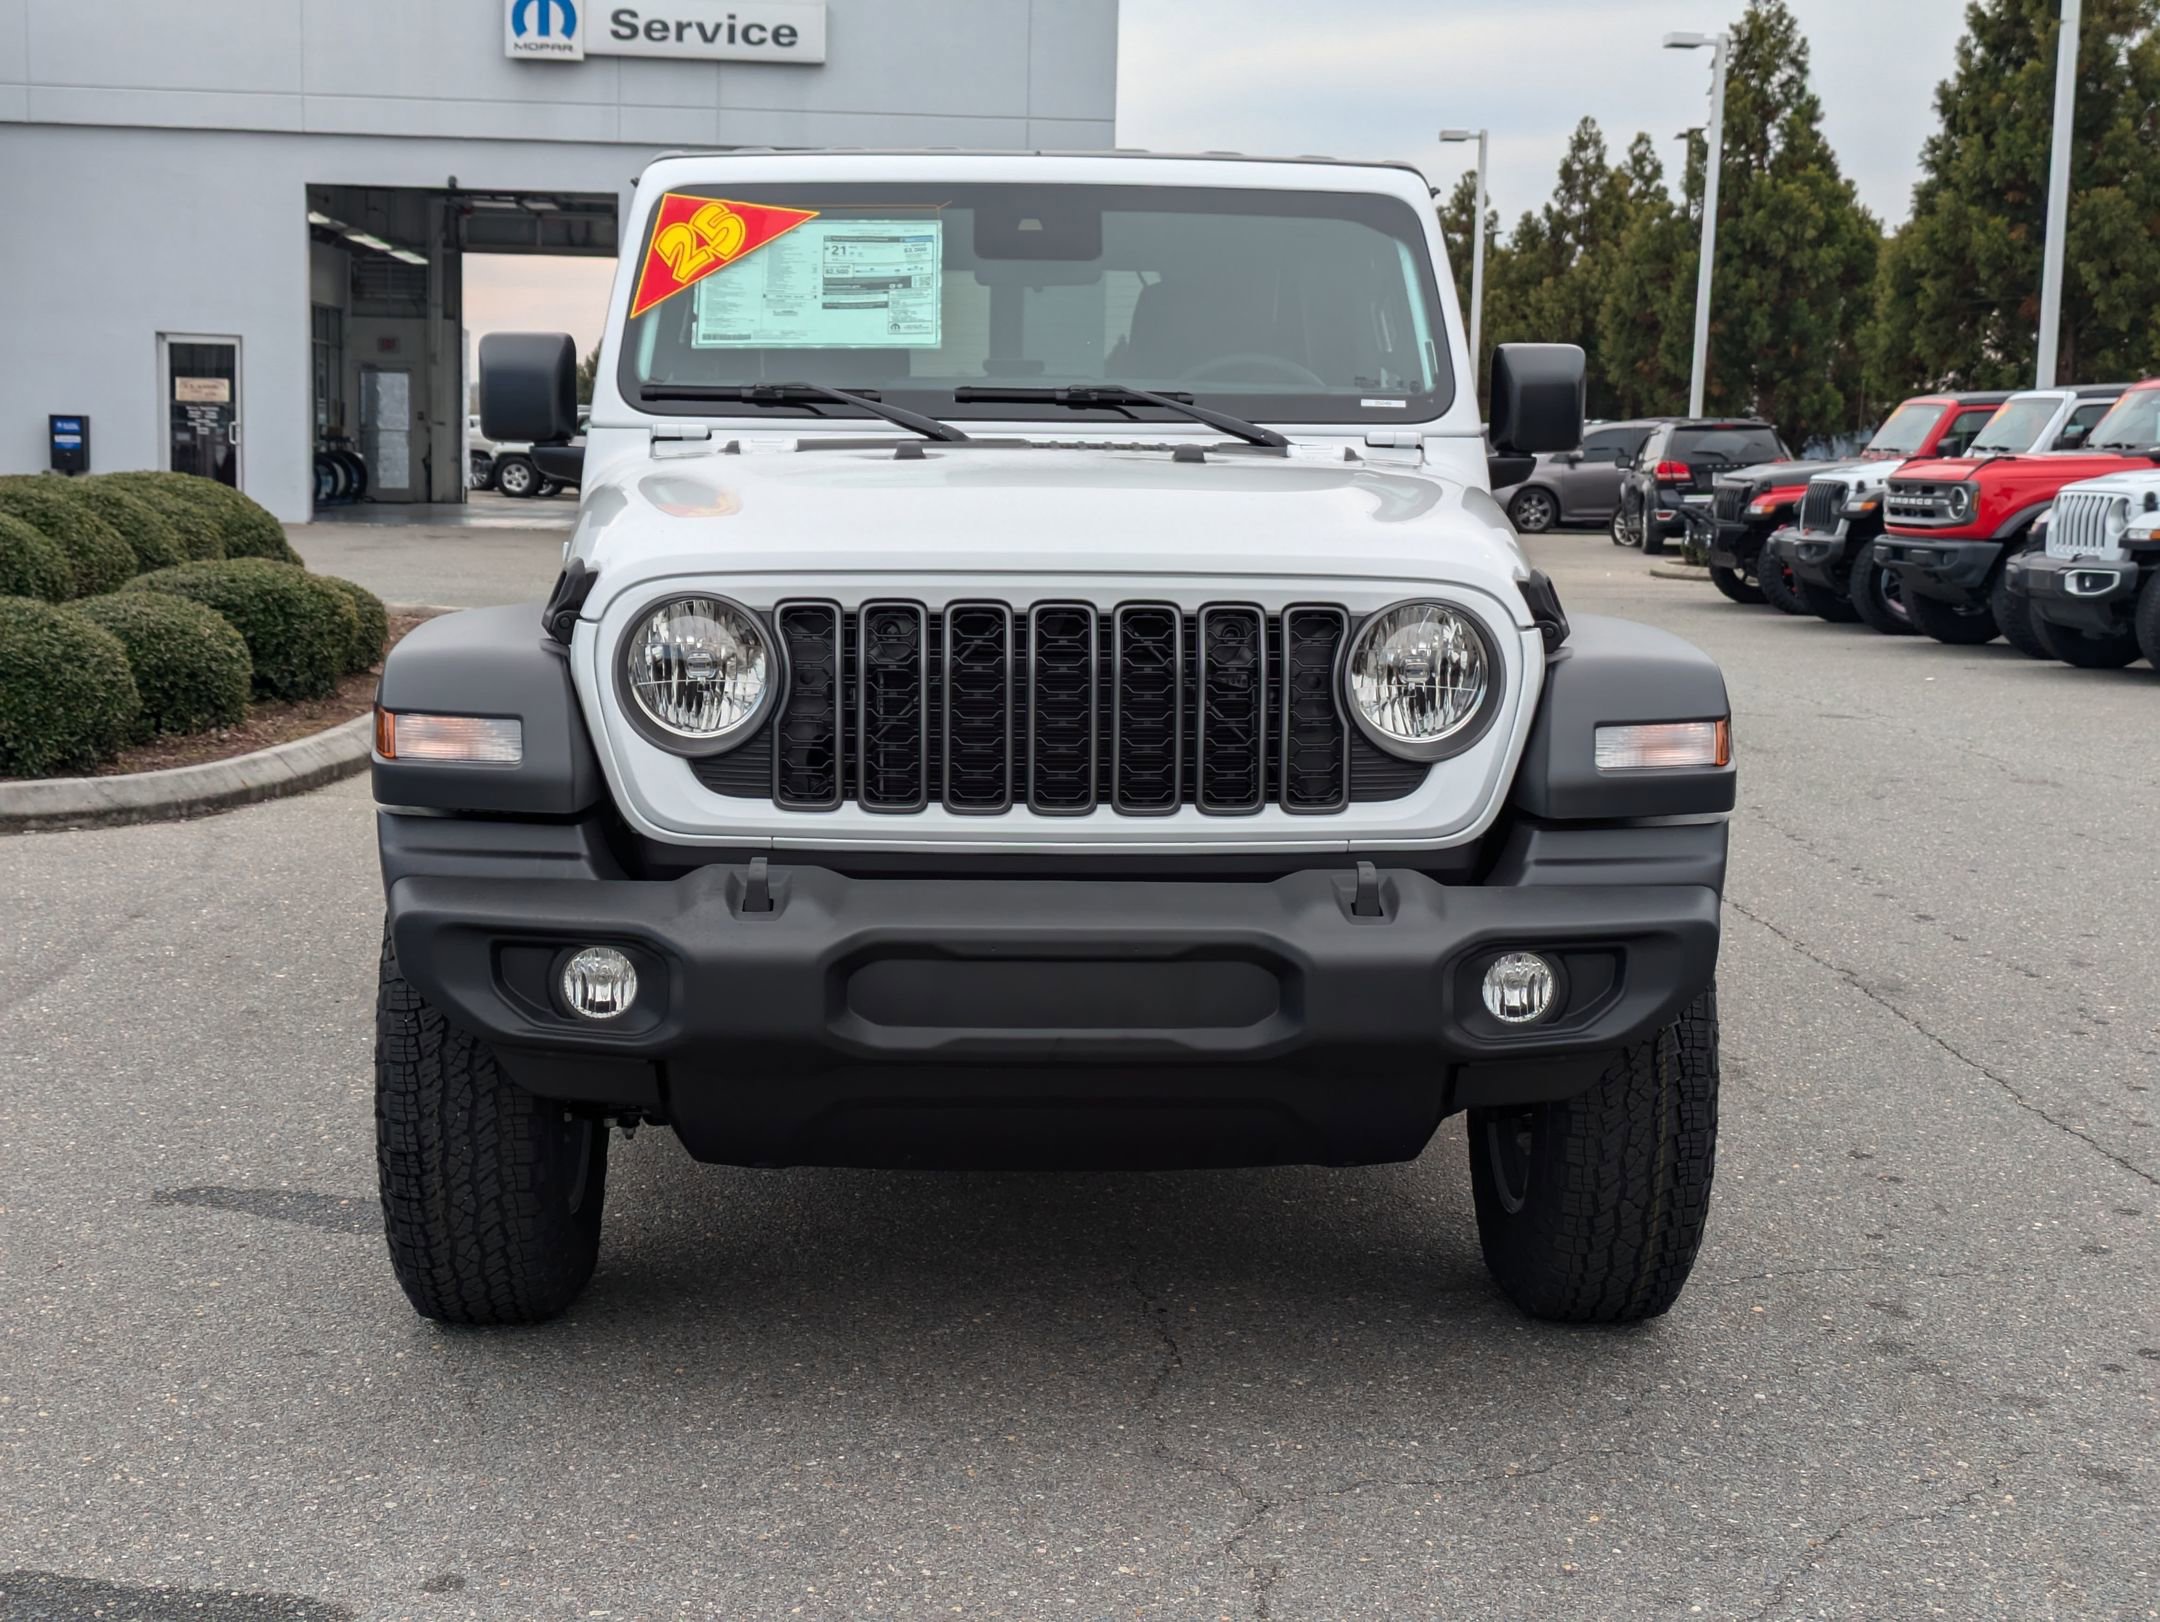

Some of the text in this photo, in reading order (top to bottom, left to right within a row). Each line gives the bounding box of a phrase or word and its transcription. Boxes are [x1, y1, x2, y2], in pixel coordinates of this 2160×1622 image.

[609, 8, 799, 47] Service
[513, 42, 574, 52] MOPAR
[654, 202, 746, 284] 25
[831, 245, 847, 256] 21
